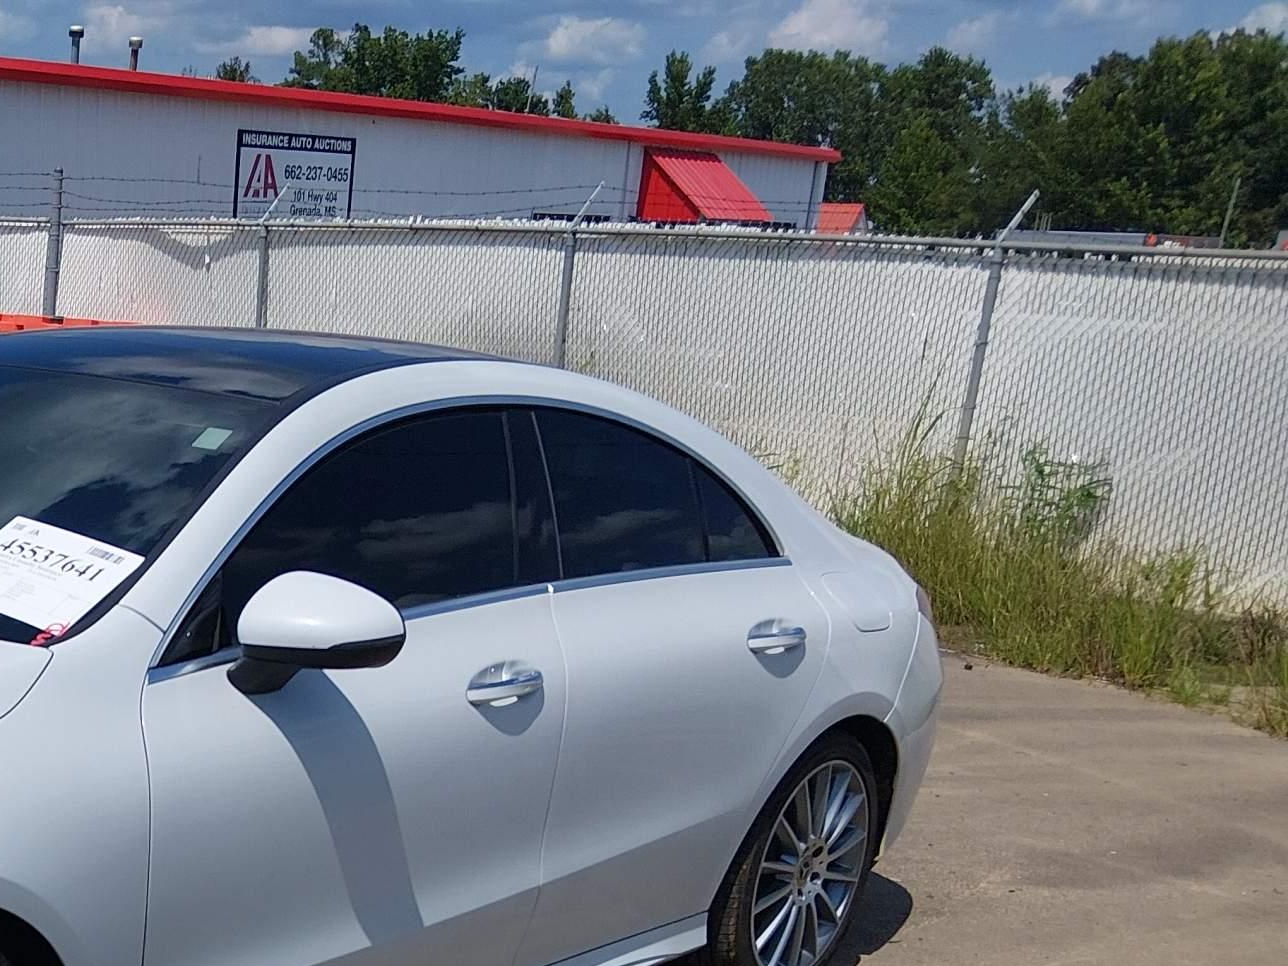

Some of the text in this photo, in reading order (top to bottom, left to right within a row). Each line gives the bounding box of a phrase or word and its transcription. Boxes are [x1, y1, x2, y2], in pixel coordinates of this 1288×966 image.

[242, 132, 352, 152] INSURANCE AUTO AUCTIONS
[284, 164, 349, 182] 662-237-0455
[293, 190, 338, 204] 101 Hwy 404
[289, 204, 322, 217] Grenada,
[324, 206, 337, 217] MS
[0, 537, 106, 582] 45537641
